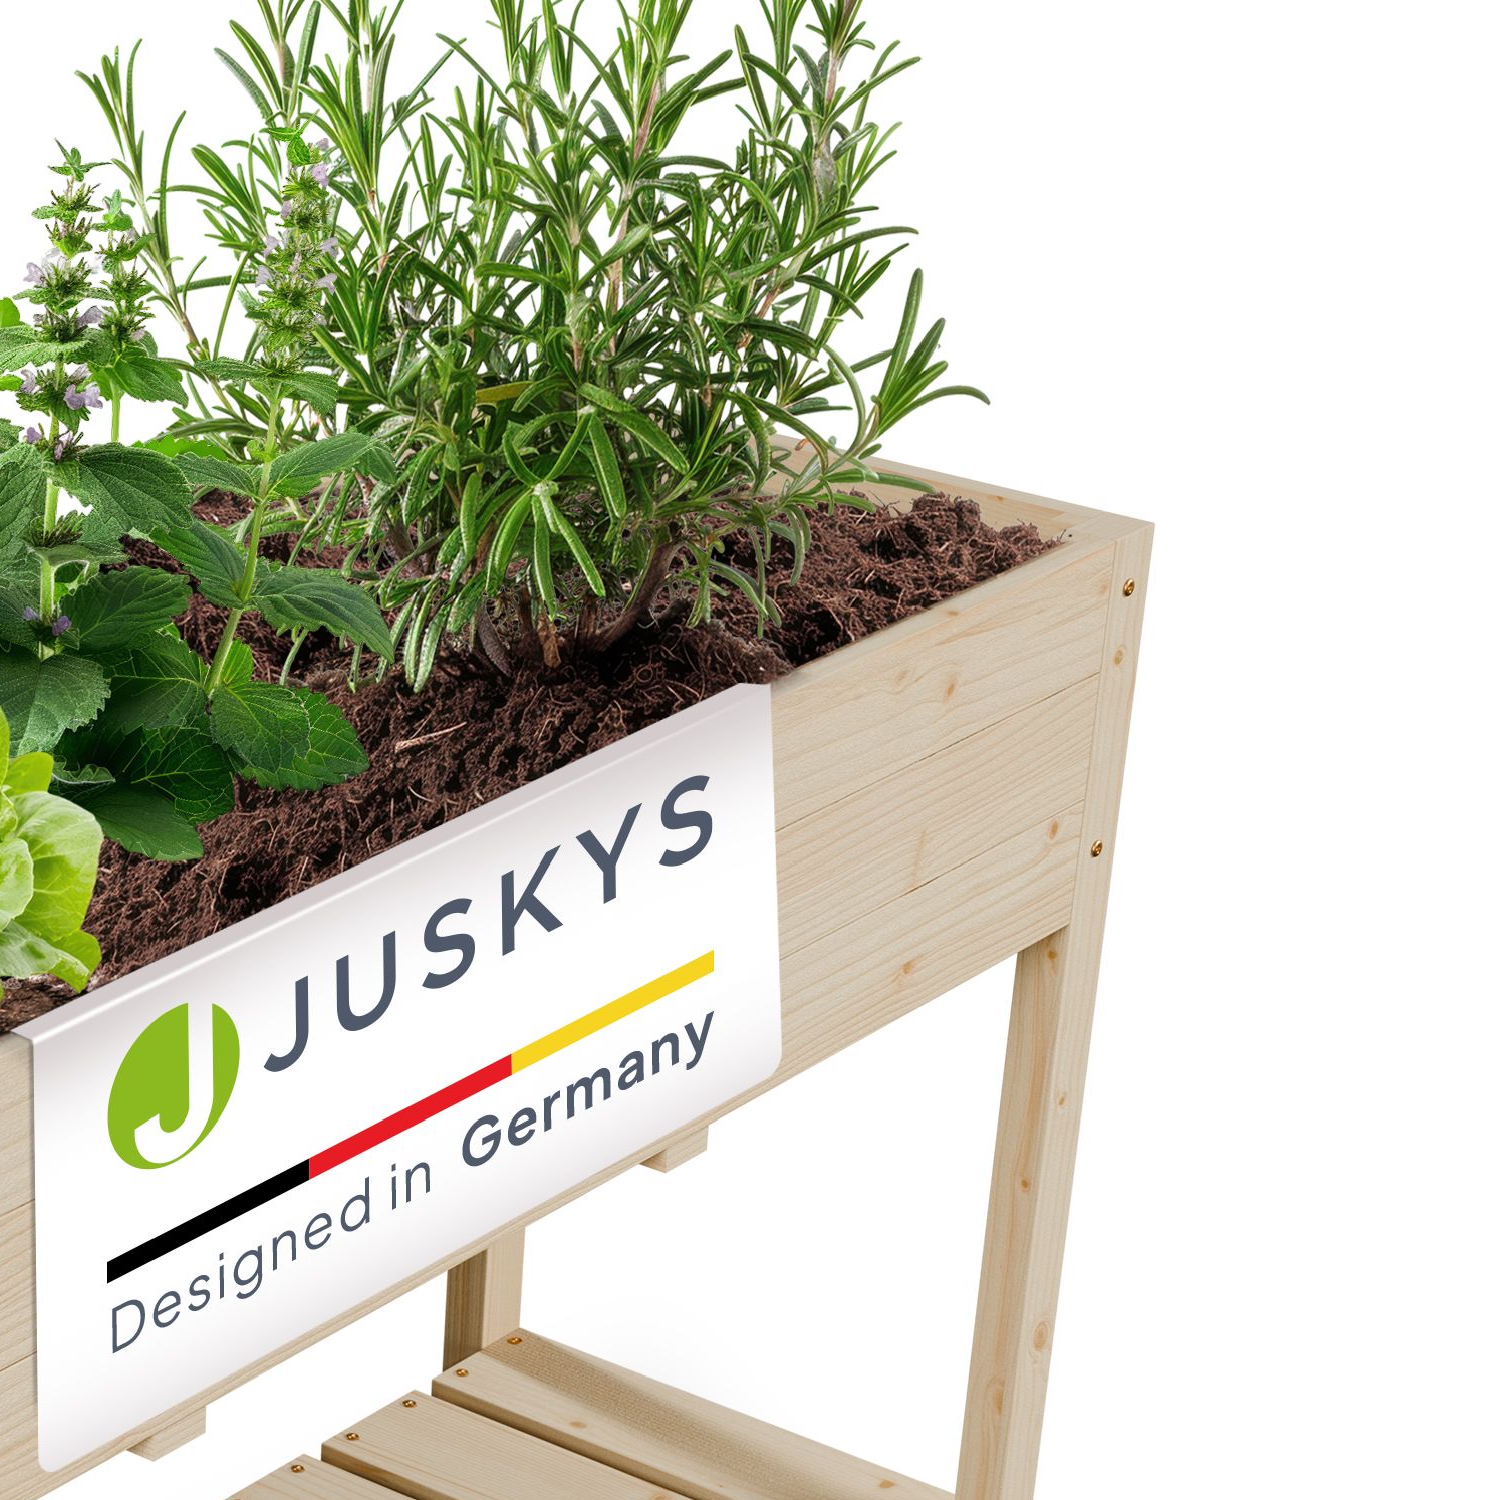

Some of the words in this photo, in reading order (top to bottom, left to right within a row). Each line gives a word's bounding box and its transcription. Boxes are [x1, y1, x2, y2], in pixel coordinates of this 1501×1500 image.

[263, 775, 714, 1073] JUSKYS
[111, 1176, 371, 1354] Designed
[389, 1162, 432, 1210] in
[462, 1010, 716, 1168] Germany
